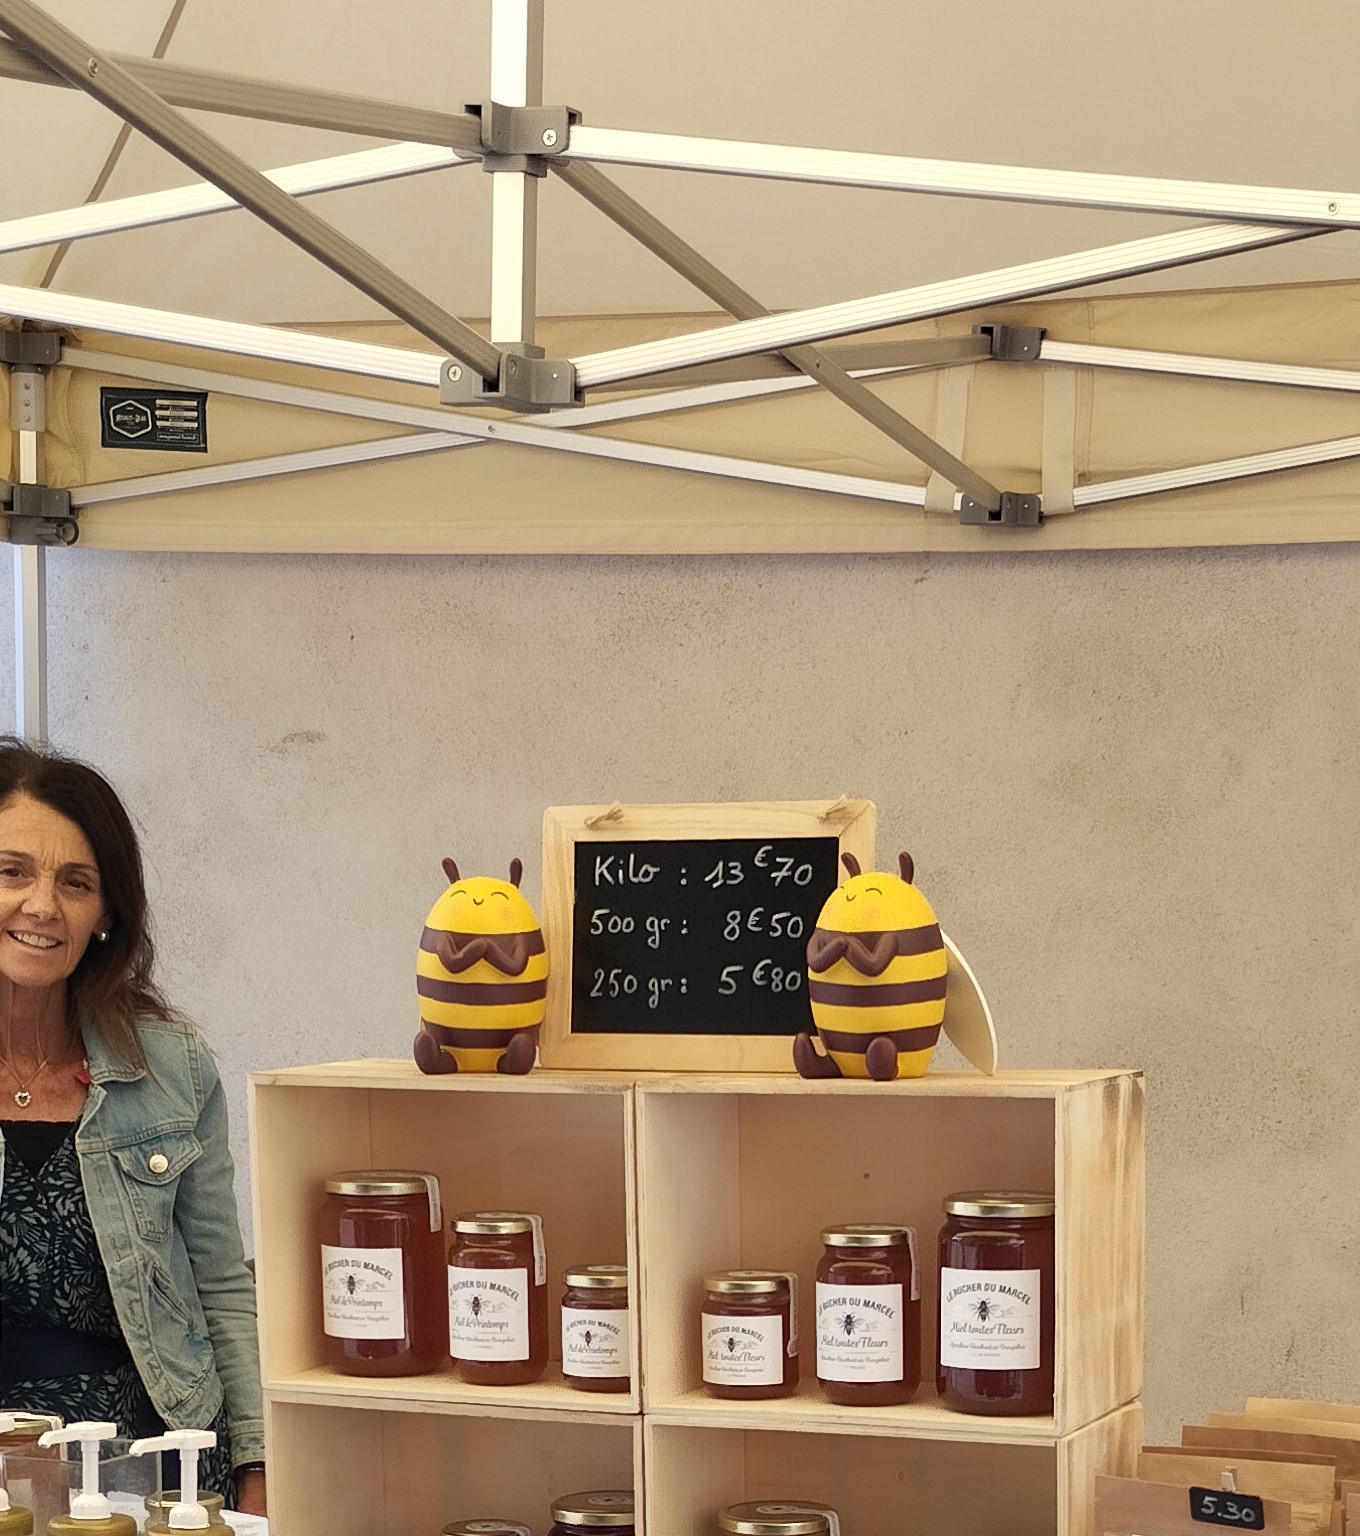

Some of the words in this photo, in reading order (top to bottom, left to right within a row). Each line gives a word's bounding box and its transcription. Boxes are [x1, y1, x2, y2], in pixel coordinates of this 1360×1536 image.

[594, 852, 660, 886] Kilo
[590, 908, 635, 935] 500
[645, 916, 671, 948] gr
[590, 968, 638, 998] 250
[648, 978, 672, 1009] gr
[863, 1299, 895, 1319] MARCEL
[984, 1283, 997, 1292] DU
[998, 1285, 1031, 1305] MARCEL
[1201, 1496, 1256, 1522] 5.30
